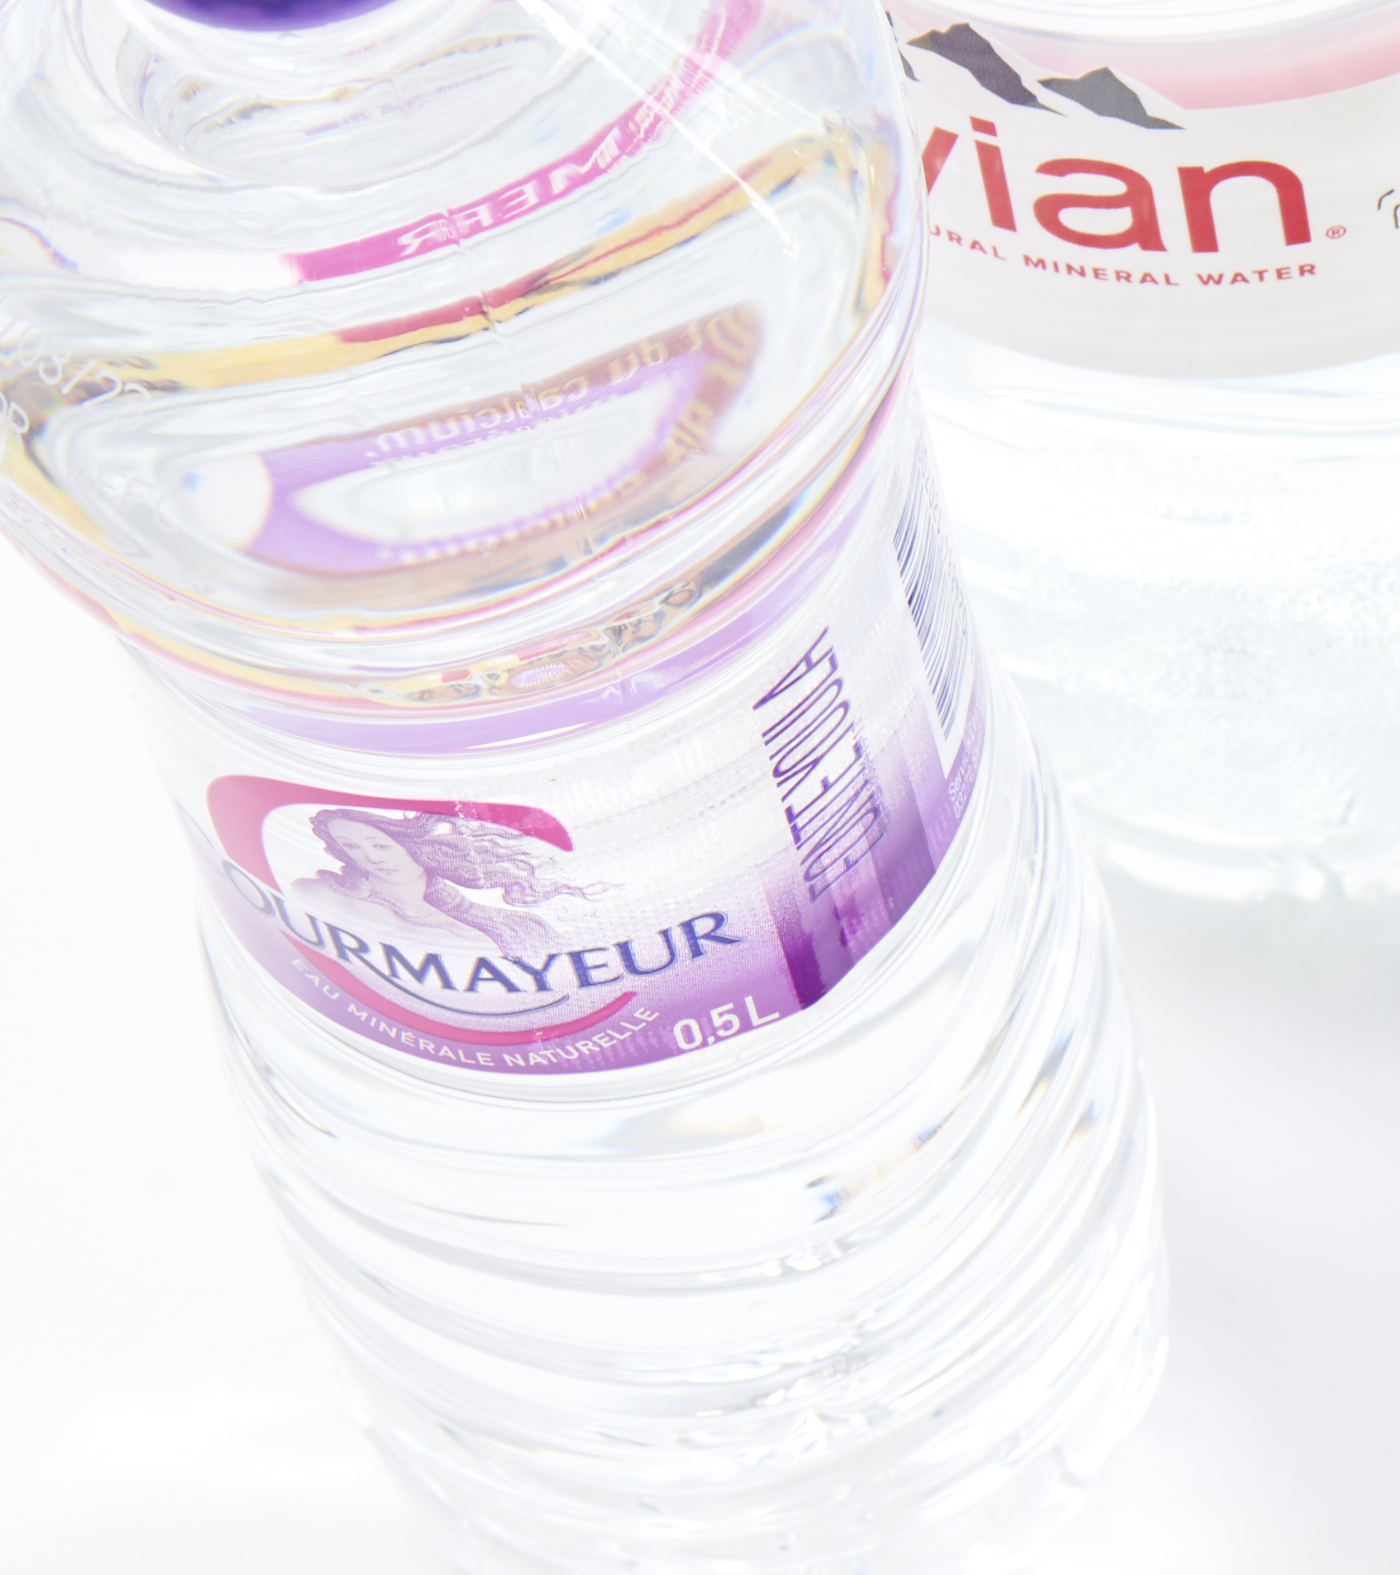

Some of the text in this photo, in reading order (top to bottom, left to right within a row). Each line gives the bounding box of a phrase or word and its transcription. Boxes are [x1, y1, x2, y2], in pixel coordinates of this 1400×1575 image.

[1023, 254, 1180, 286] MINERAL
[1196, 262, 1317, 286] WATER
[290, 957, 660, 1067] EAU MINÉRALE NATURELLE
